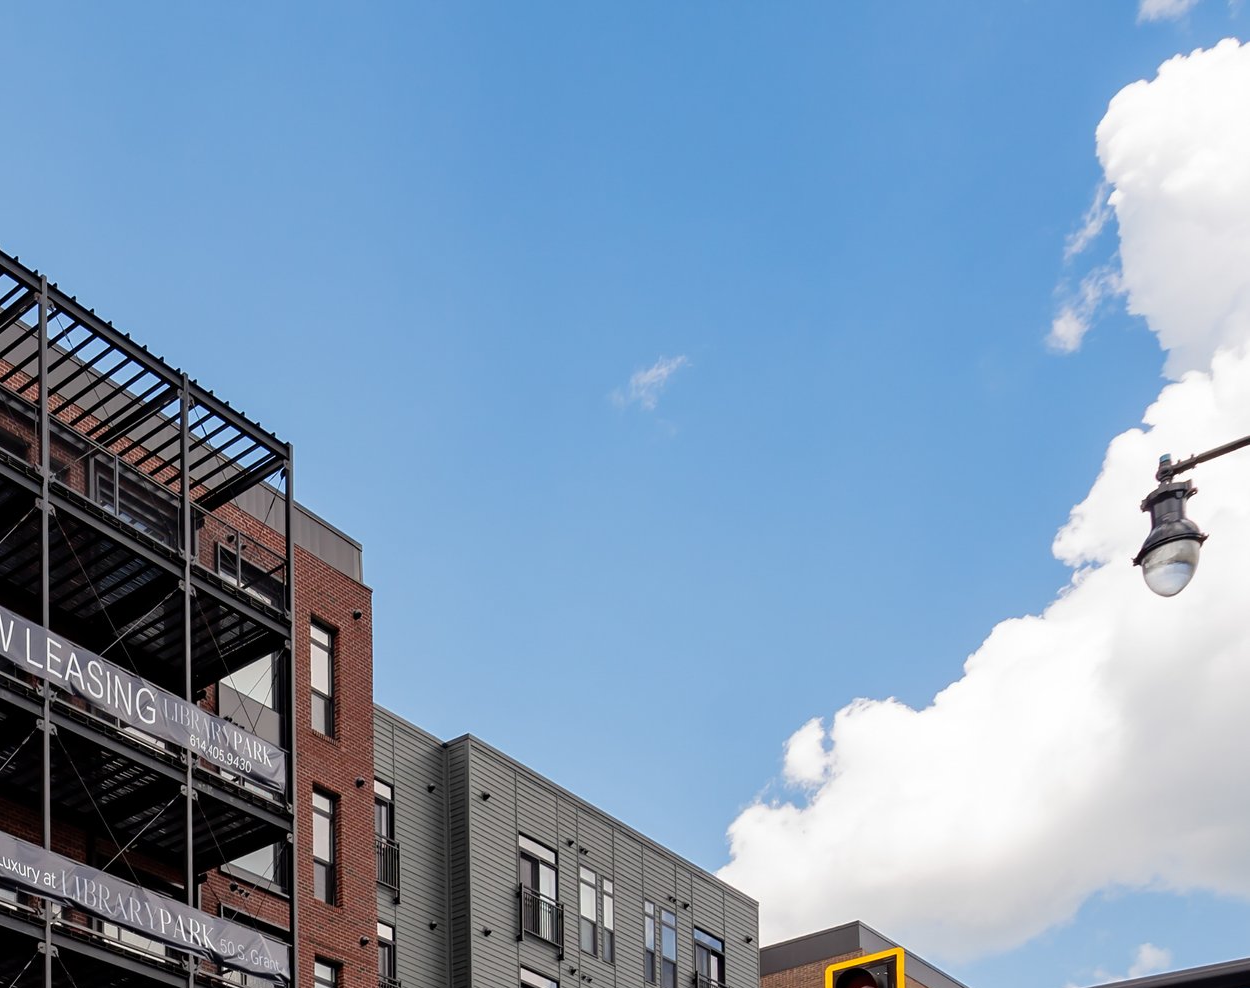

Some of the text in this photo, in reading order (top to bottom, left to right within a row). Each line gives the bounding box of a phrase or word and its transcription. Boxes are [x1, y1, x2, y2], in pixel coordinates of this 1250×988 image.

[25, 627, 157, 725] LEASING
[163, 698, 273, 769] LIBRARYPARK
[189, 733, 252, 774] 614.405.9430
[43, 872, 57, 889] at
[61, 869, 217, 951] LIBRARYPARK
[220, 938, 235, 956] 50
[237, 944, 248, 961] S.
[250, 949, 281, 972] Grant
